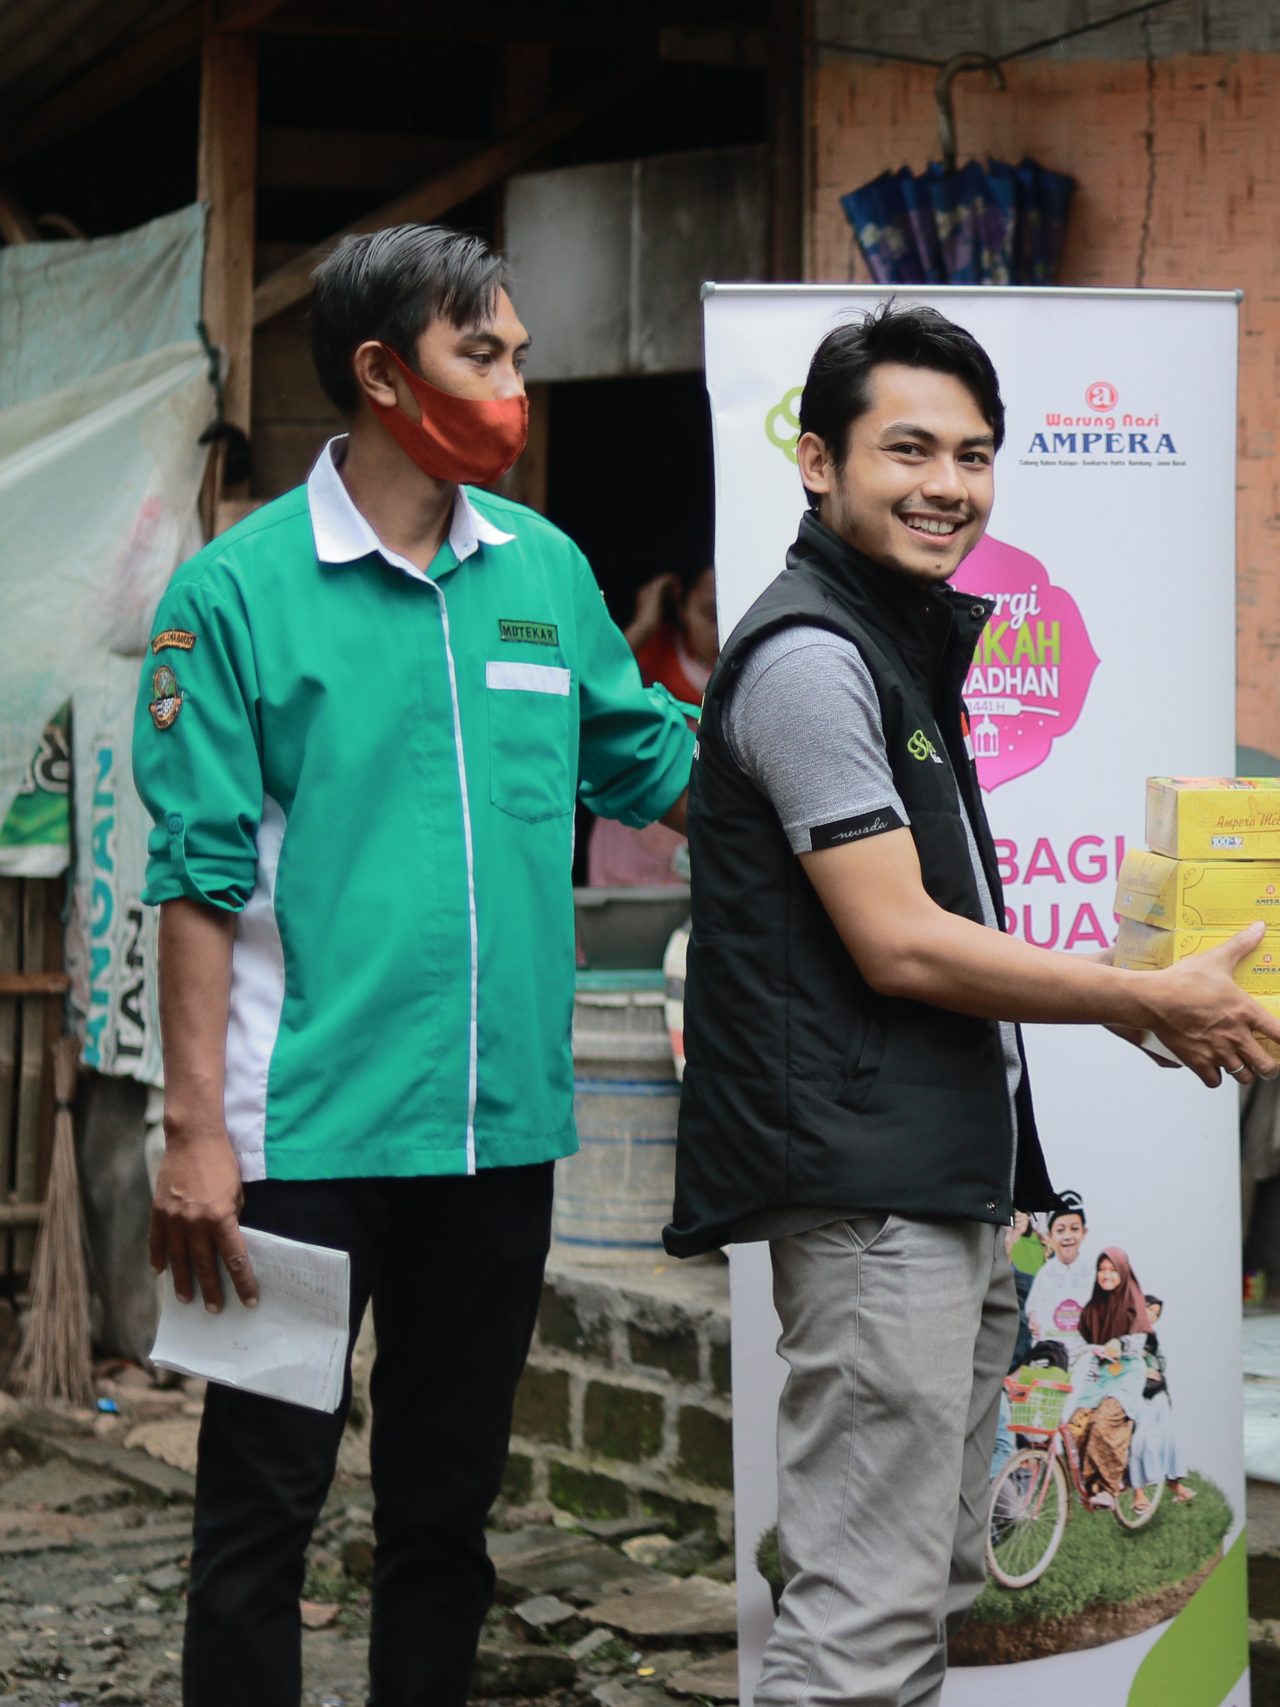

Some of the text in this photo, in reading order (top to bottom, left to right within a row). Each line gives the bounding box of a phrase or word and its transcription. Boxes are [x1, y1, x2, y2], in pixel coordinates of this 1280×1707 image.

[1045, 414, 1159, 430] Warung Nasi
[1028, 432, 1177, 454] AMPERA
[502, 625, 554, 641] MOTEKAR
[973, 620, 1061, 665] KAH
[961, 666, 1059, 698] ADHAN
[831, 816, 889, 840] nevada
[1216, 815, 1256, 829] Ampera
